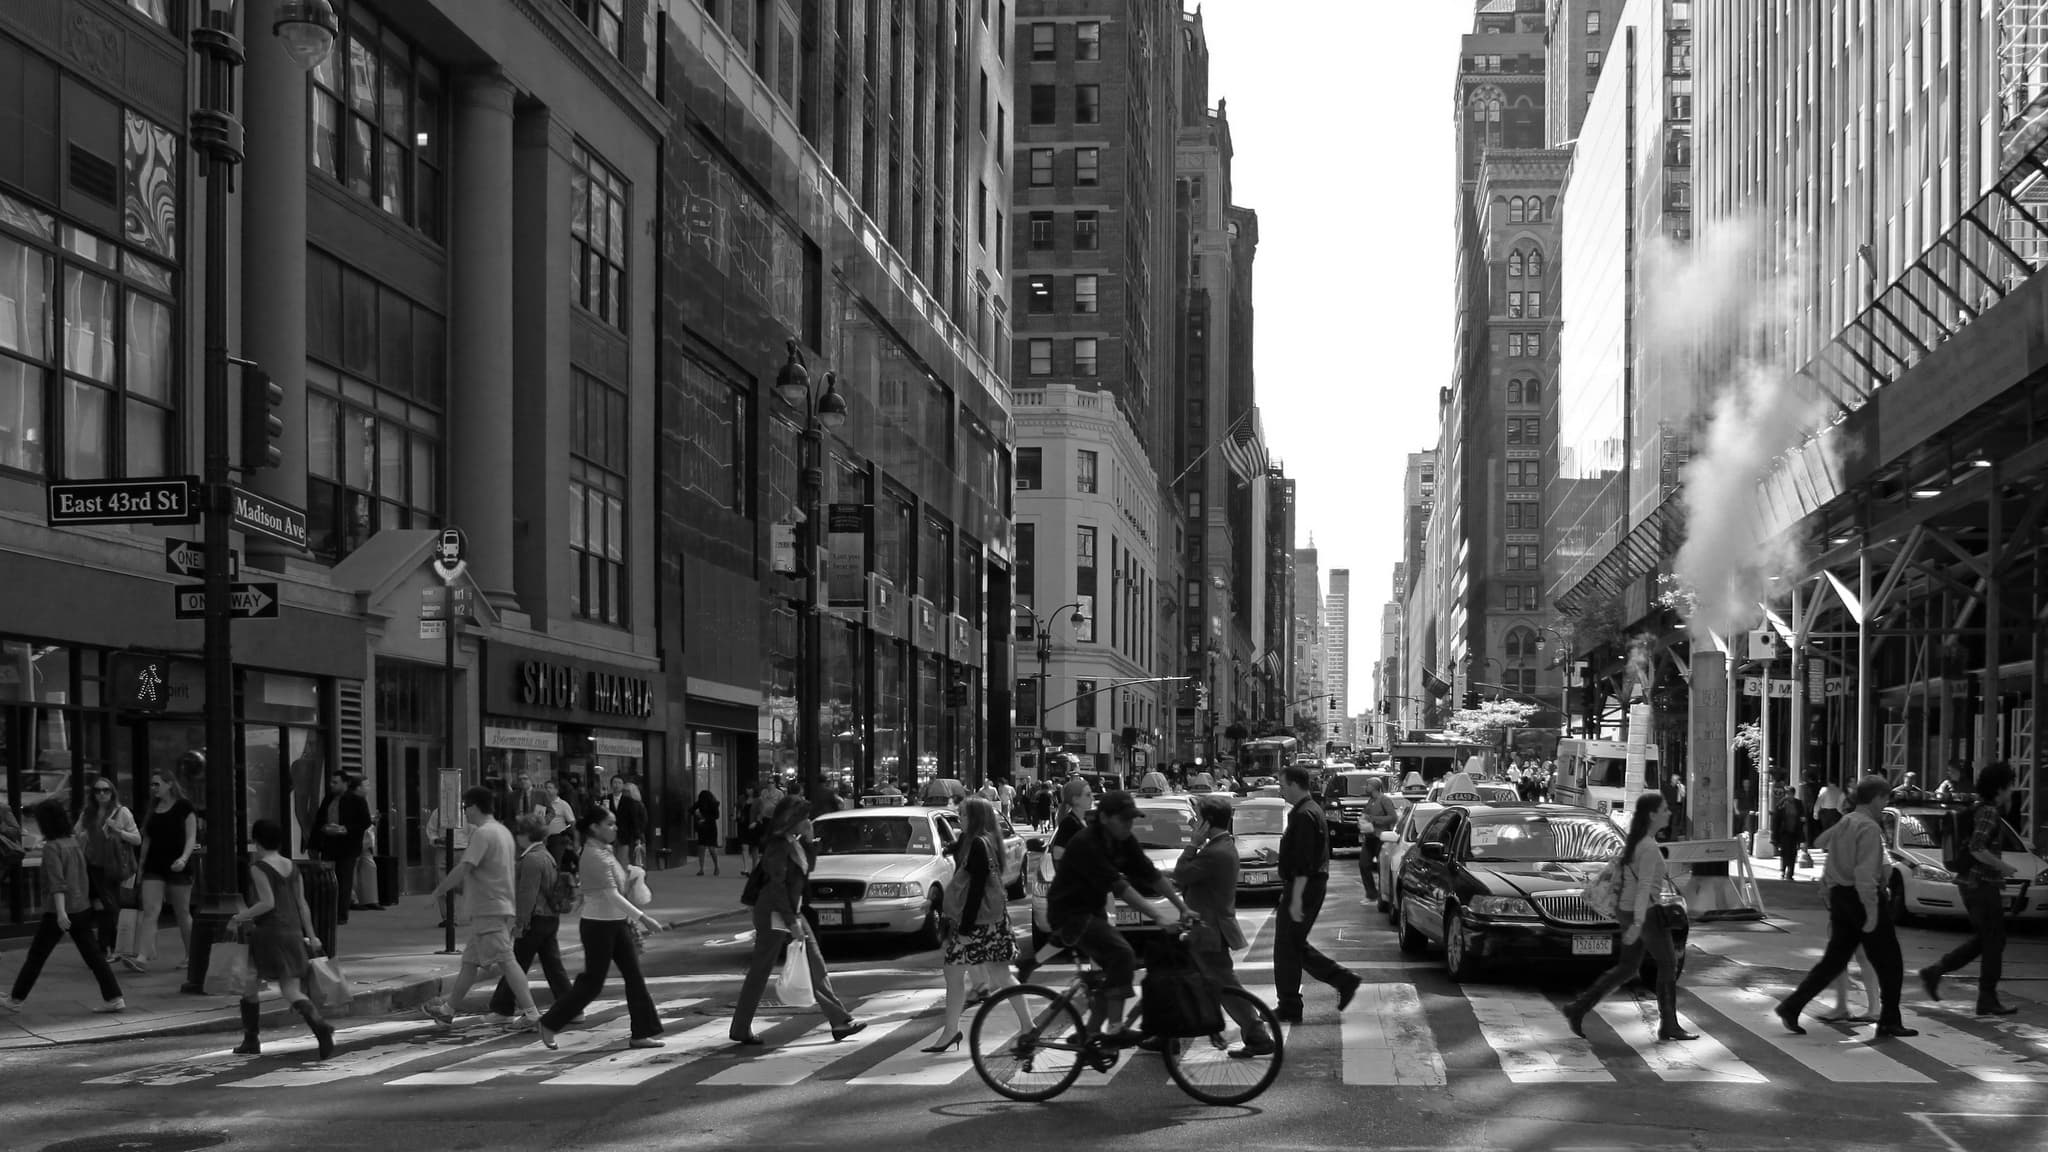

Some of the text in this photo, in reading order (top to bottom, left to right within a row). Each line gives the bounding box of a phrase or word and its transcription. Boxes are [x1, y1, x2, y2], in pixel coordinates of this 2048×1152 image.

[60, 490, 179, 513] East 43rd St
[235, 496, 305, 539] Madison Ave
[177, 550, 200, 567] ONE
[189, 594, 262, 608] ON WAY
